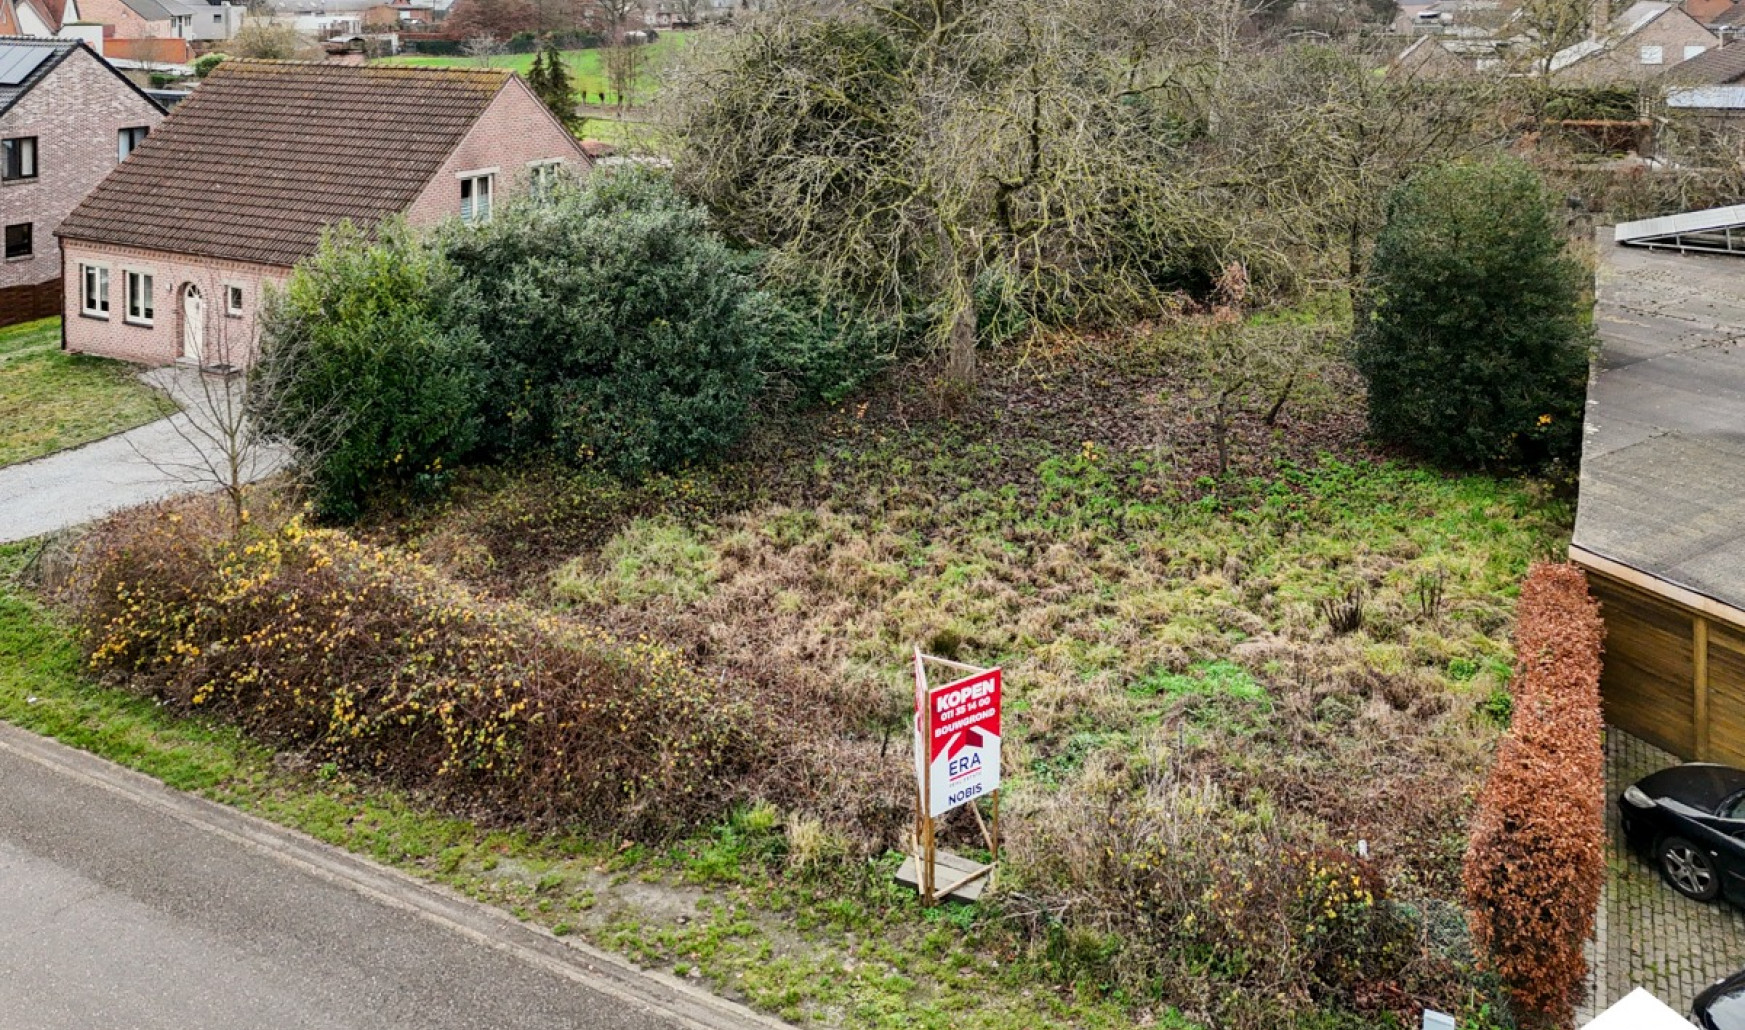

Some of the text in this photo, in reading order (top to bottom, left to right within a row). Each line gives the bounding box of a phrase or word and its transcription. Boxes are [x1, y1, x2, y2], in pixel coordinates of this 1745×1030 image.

[937, 678, 995, 713] KOPEN
[967, 702, 977, 712] 14
[934, 708, 996, 738] BOUWGROND
[949, 752, 981, 776] ERA
[948, 783, 983, 806] NOBIS
